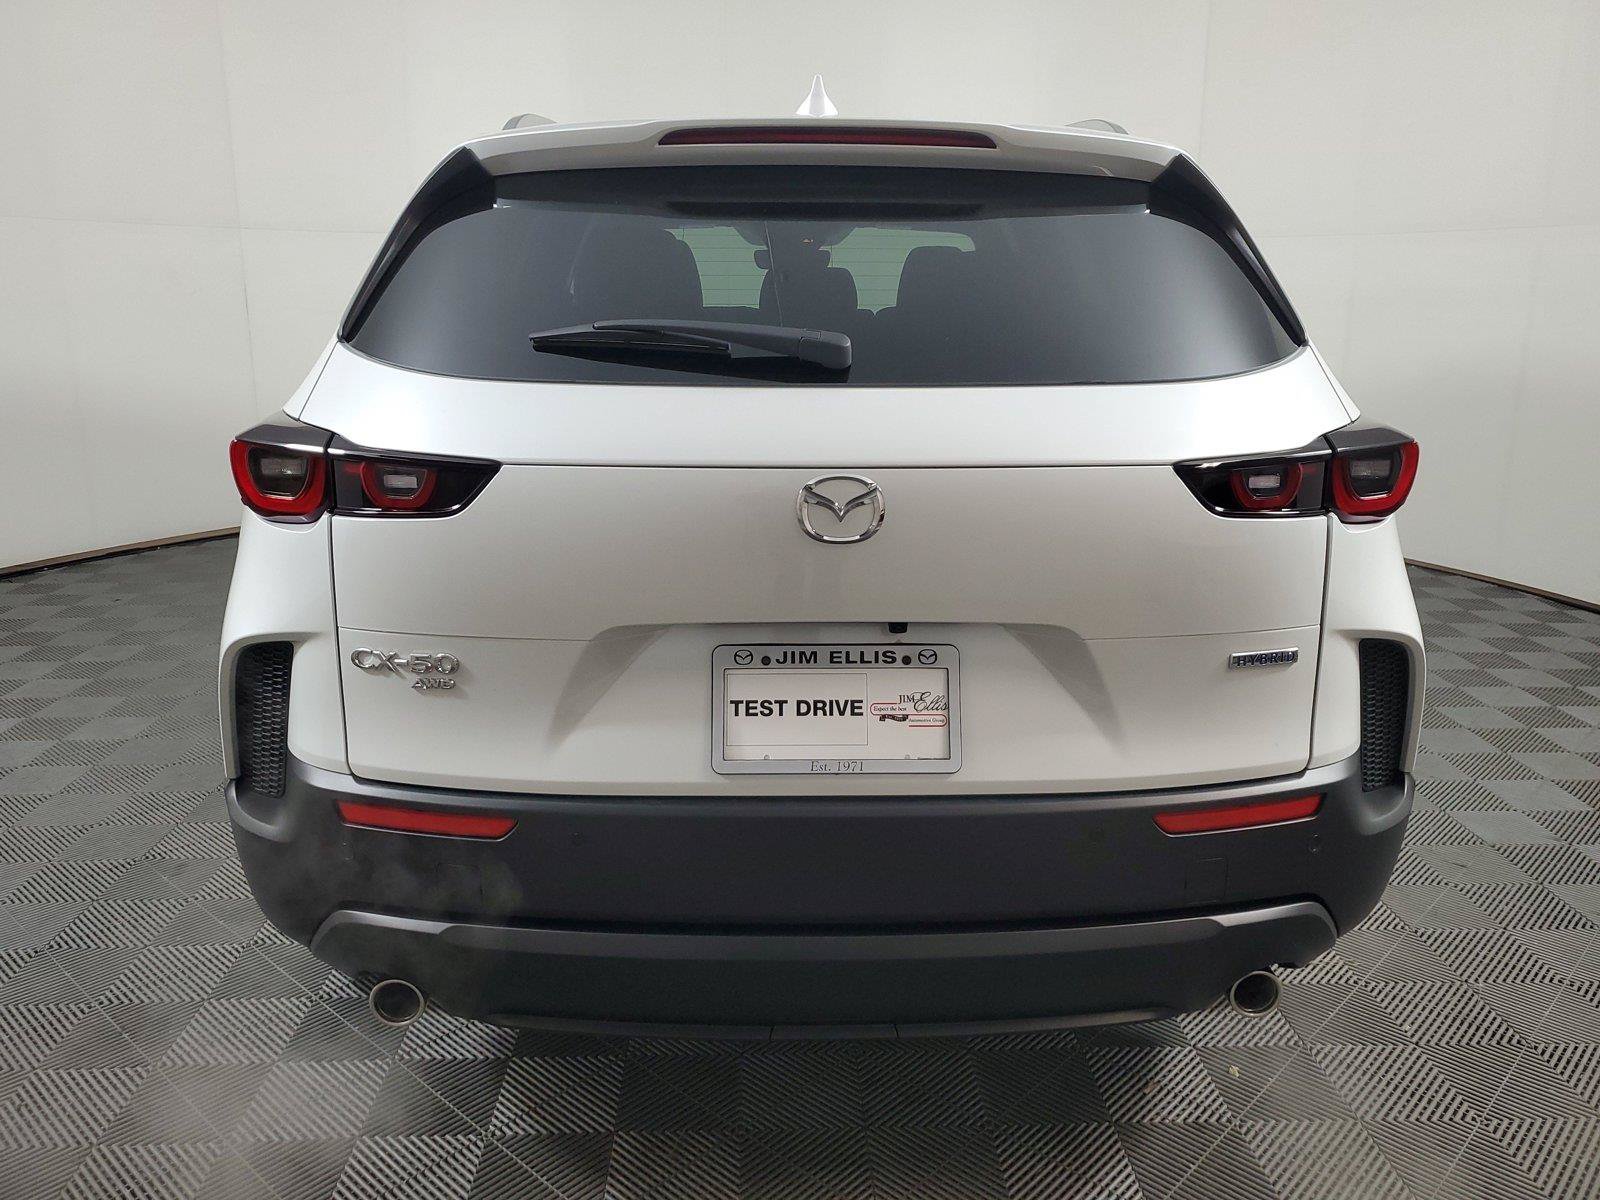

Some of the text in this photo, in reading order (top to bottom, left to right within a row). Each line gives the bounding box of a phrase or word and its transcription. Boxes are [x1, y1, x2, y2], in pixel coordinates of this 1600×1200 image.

[350, 647, 460, 675] CX-50
[775, 650, 898, 665] JIM ELLIS
[1231, 650, 1296, 668] HYBRID
[411, 678, 456, 691] AWD
[730, 699, 864, 717] TEST DRIVE
[898, 691, 949, 713] JIM Ellis
[810, 760, 864, 773] Est. 1971
